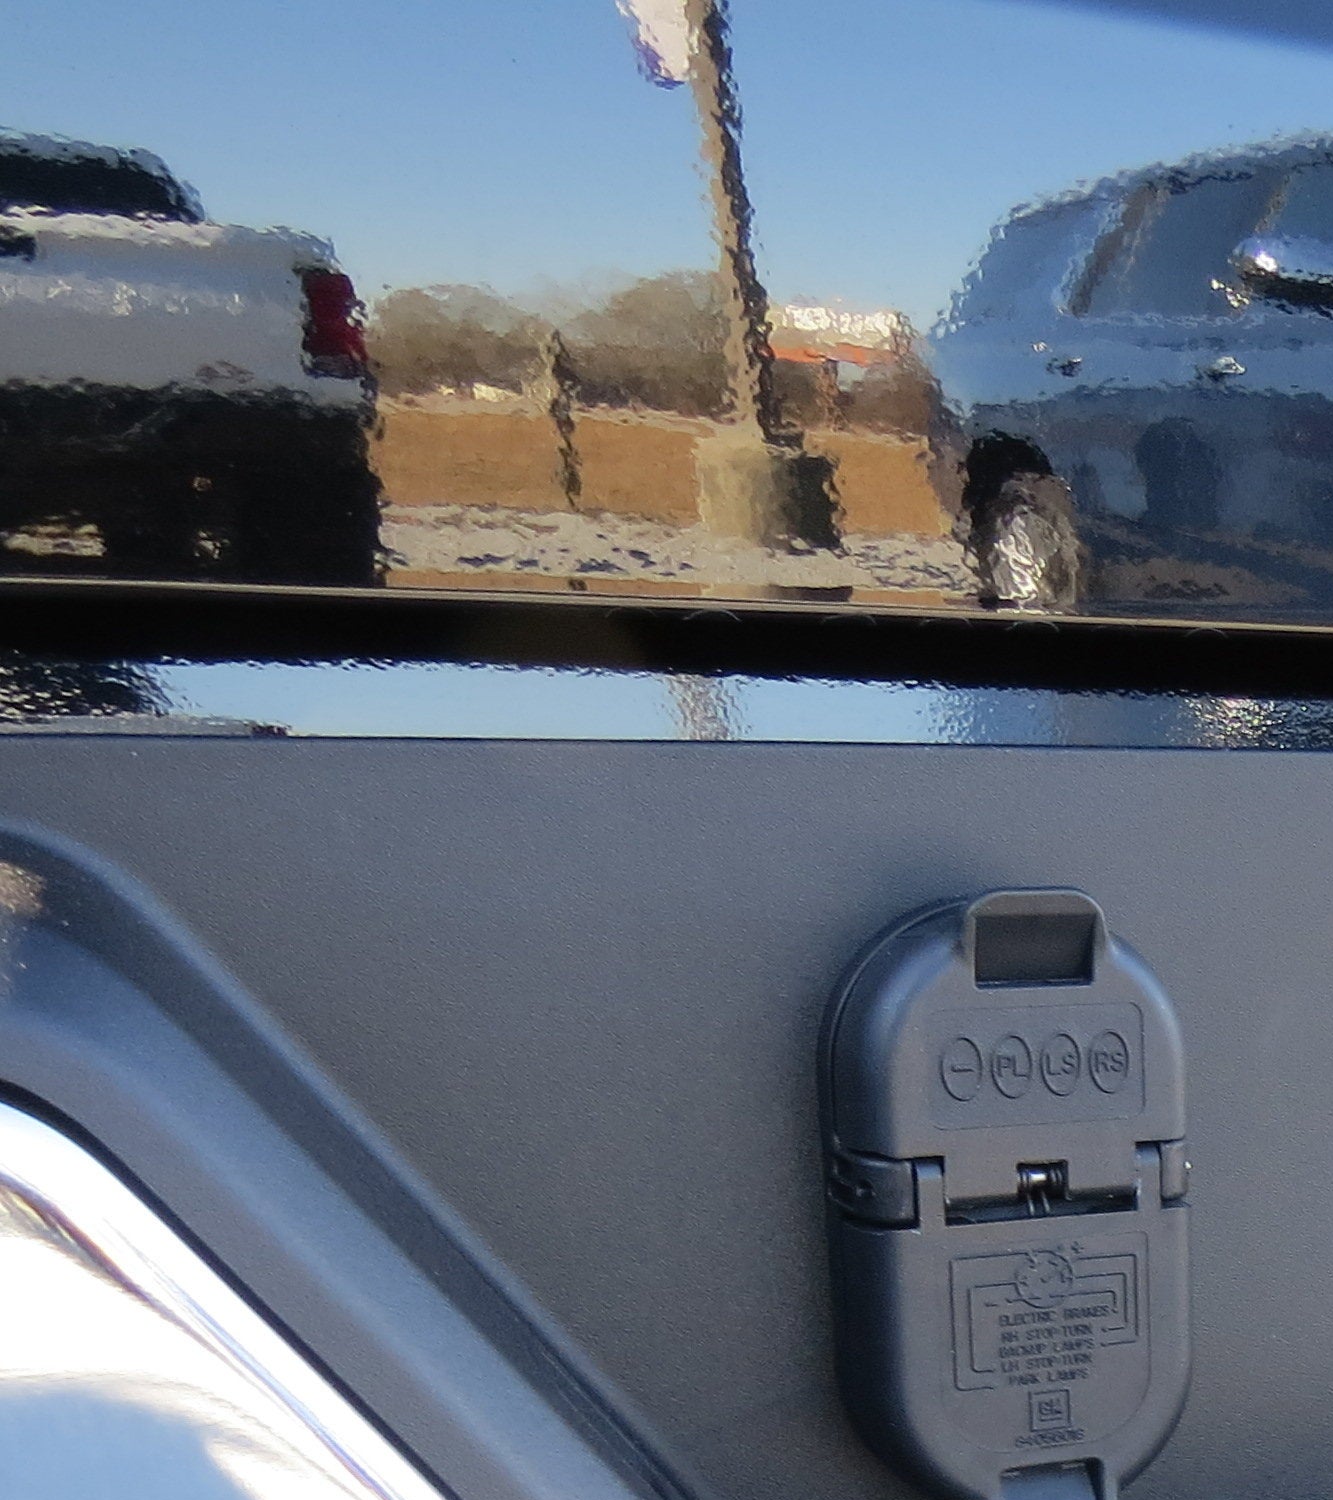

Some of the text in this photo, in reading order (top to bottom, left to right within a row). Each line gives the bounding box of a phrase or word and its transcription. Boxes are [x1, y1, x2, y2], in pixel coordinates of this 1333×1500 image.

[1045, 1053, 1076, 1076] LS
[999, 1304, 1110, 1327] ELECTRIC BRAKES
